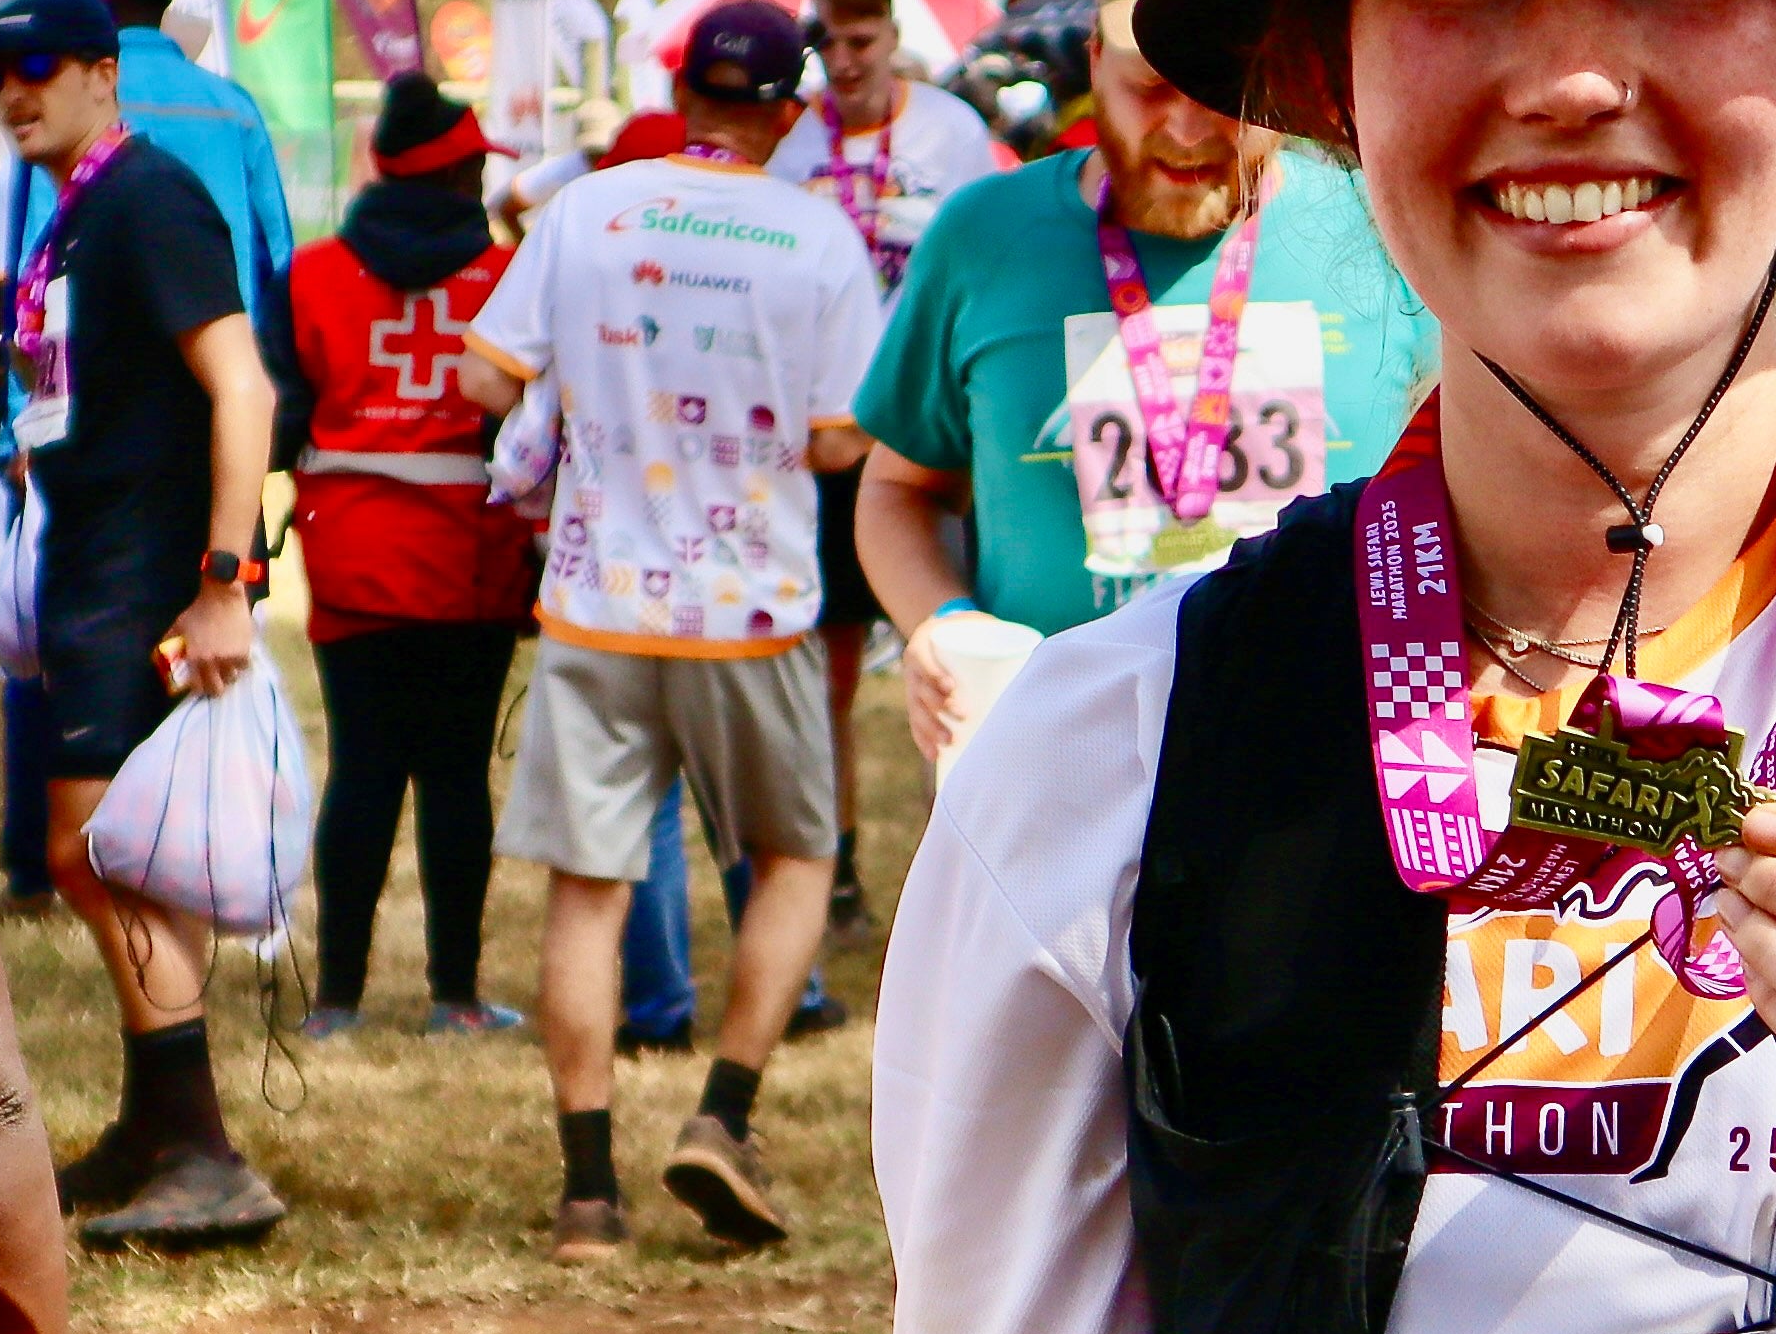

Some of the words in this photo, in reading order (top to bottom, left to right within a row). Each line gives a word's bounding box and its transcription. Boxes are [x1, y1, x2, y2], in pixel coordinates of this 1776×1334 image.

[639, 205, 798, 252] Safaricom
[668, 270, 752, 295] HUAWEI
[1381, 500, 1400, 541] 2025
[1365, 522, 1384, 568] SAFARI
[1411, 521, 1447, 595] 21KM
[1369, 570, 1387, 607] LEWA
[1386, 544, 1408, 620] MARATHON
[1536, 758, 1677, 820] SAFARI
[1530, 801, 1663, 841] MARATHON
